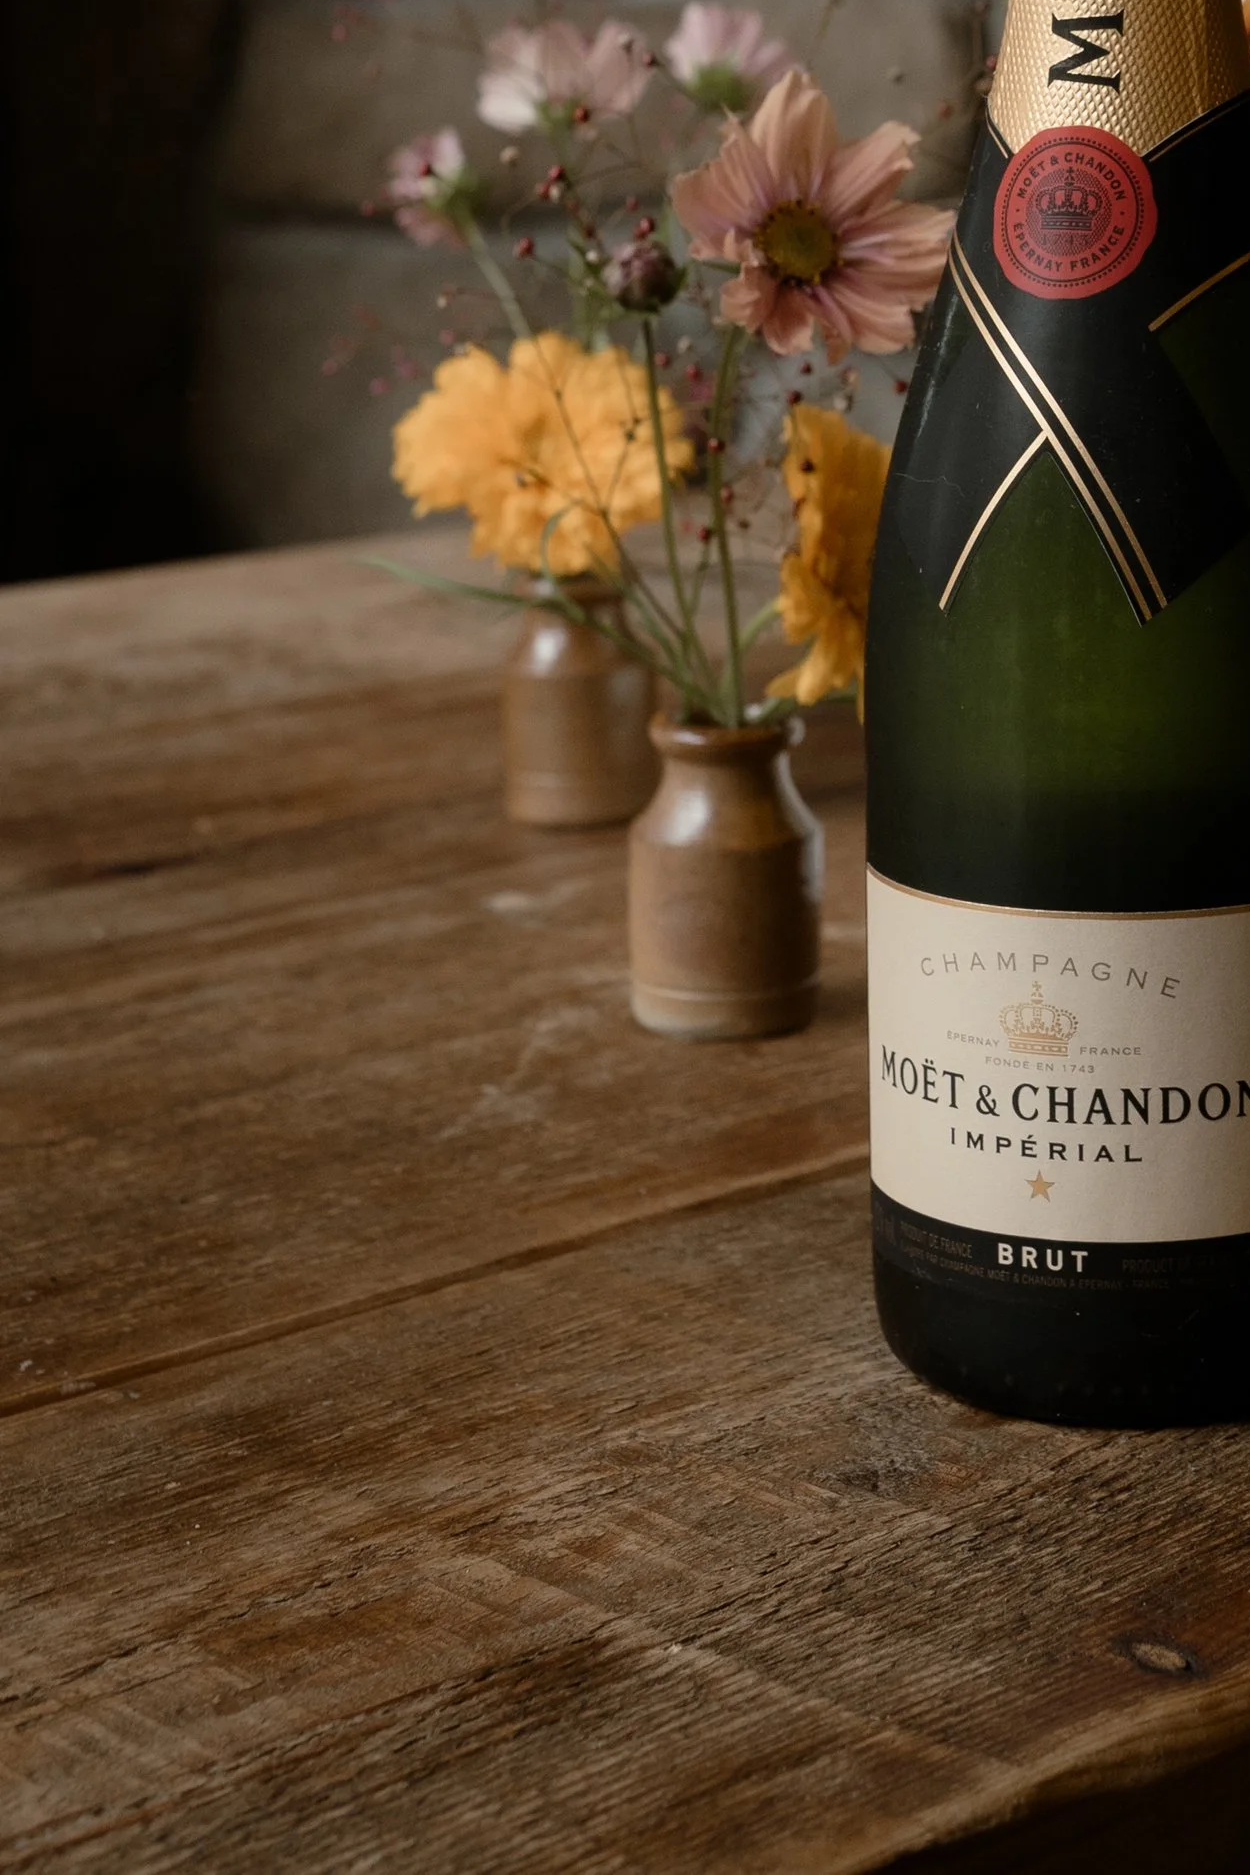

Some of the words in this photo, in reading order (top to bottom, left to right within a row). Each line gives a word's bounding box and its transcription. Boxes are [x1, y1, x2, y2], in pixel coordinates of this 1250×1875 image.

[1050, 156, 1059, 166] &
[1064, 152, 1127, 201] CHANDON
[1070, 225, 1125, 272] FRANCE
[920, 951, 1181, 999] CHAMPAGNE
[1079, 1046, 1142, 1056] FRANCE
[880, 1045, 965, 1109] MOËT
[976, 1085, 1000, 1118] &
[1036, 1061, 1054, 1072] EN
[1062, 1064, 1095, 1074] 1743
[950, 1127, 1143, 1163] IMPÉRIAL
[940, 1236, 973, 1259] FRANCE
[997, 1242, 1088, 1273] BRUT
[1021, 1272, 1067, 1288] CHANDON
[1122, 1256, 1173, 1274] PRODUCT
